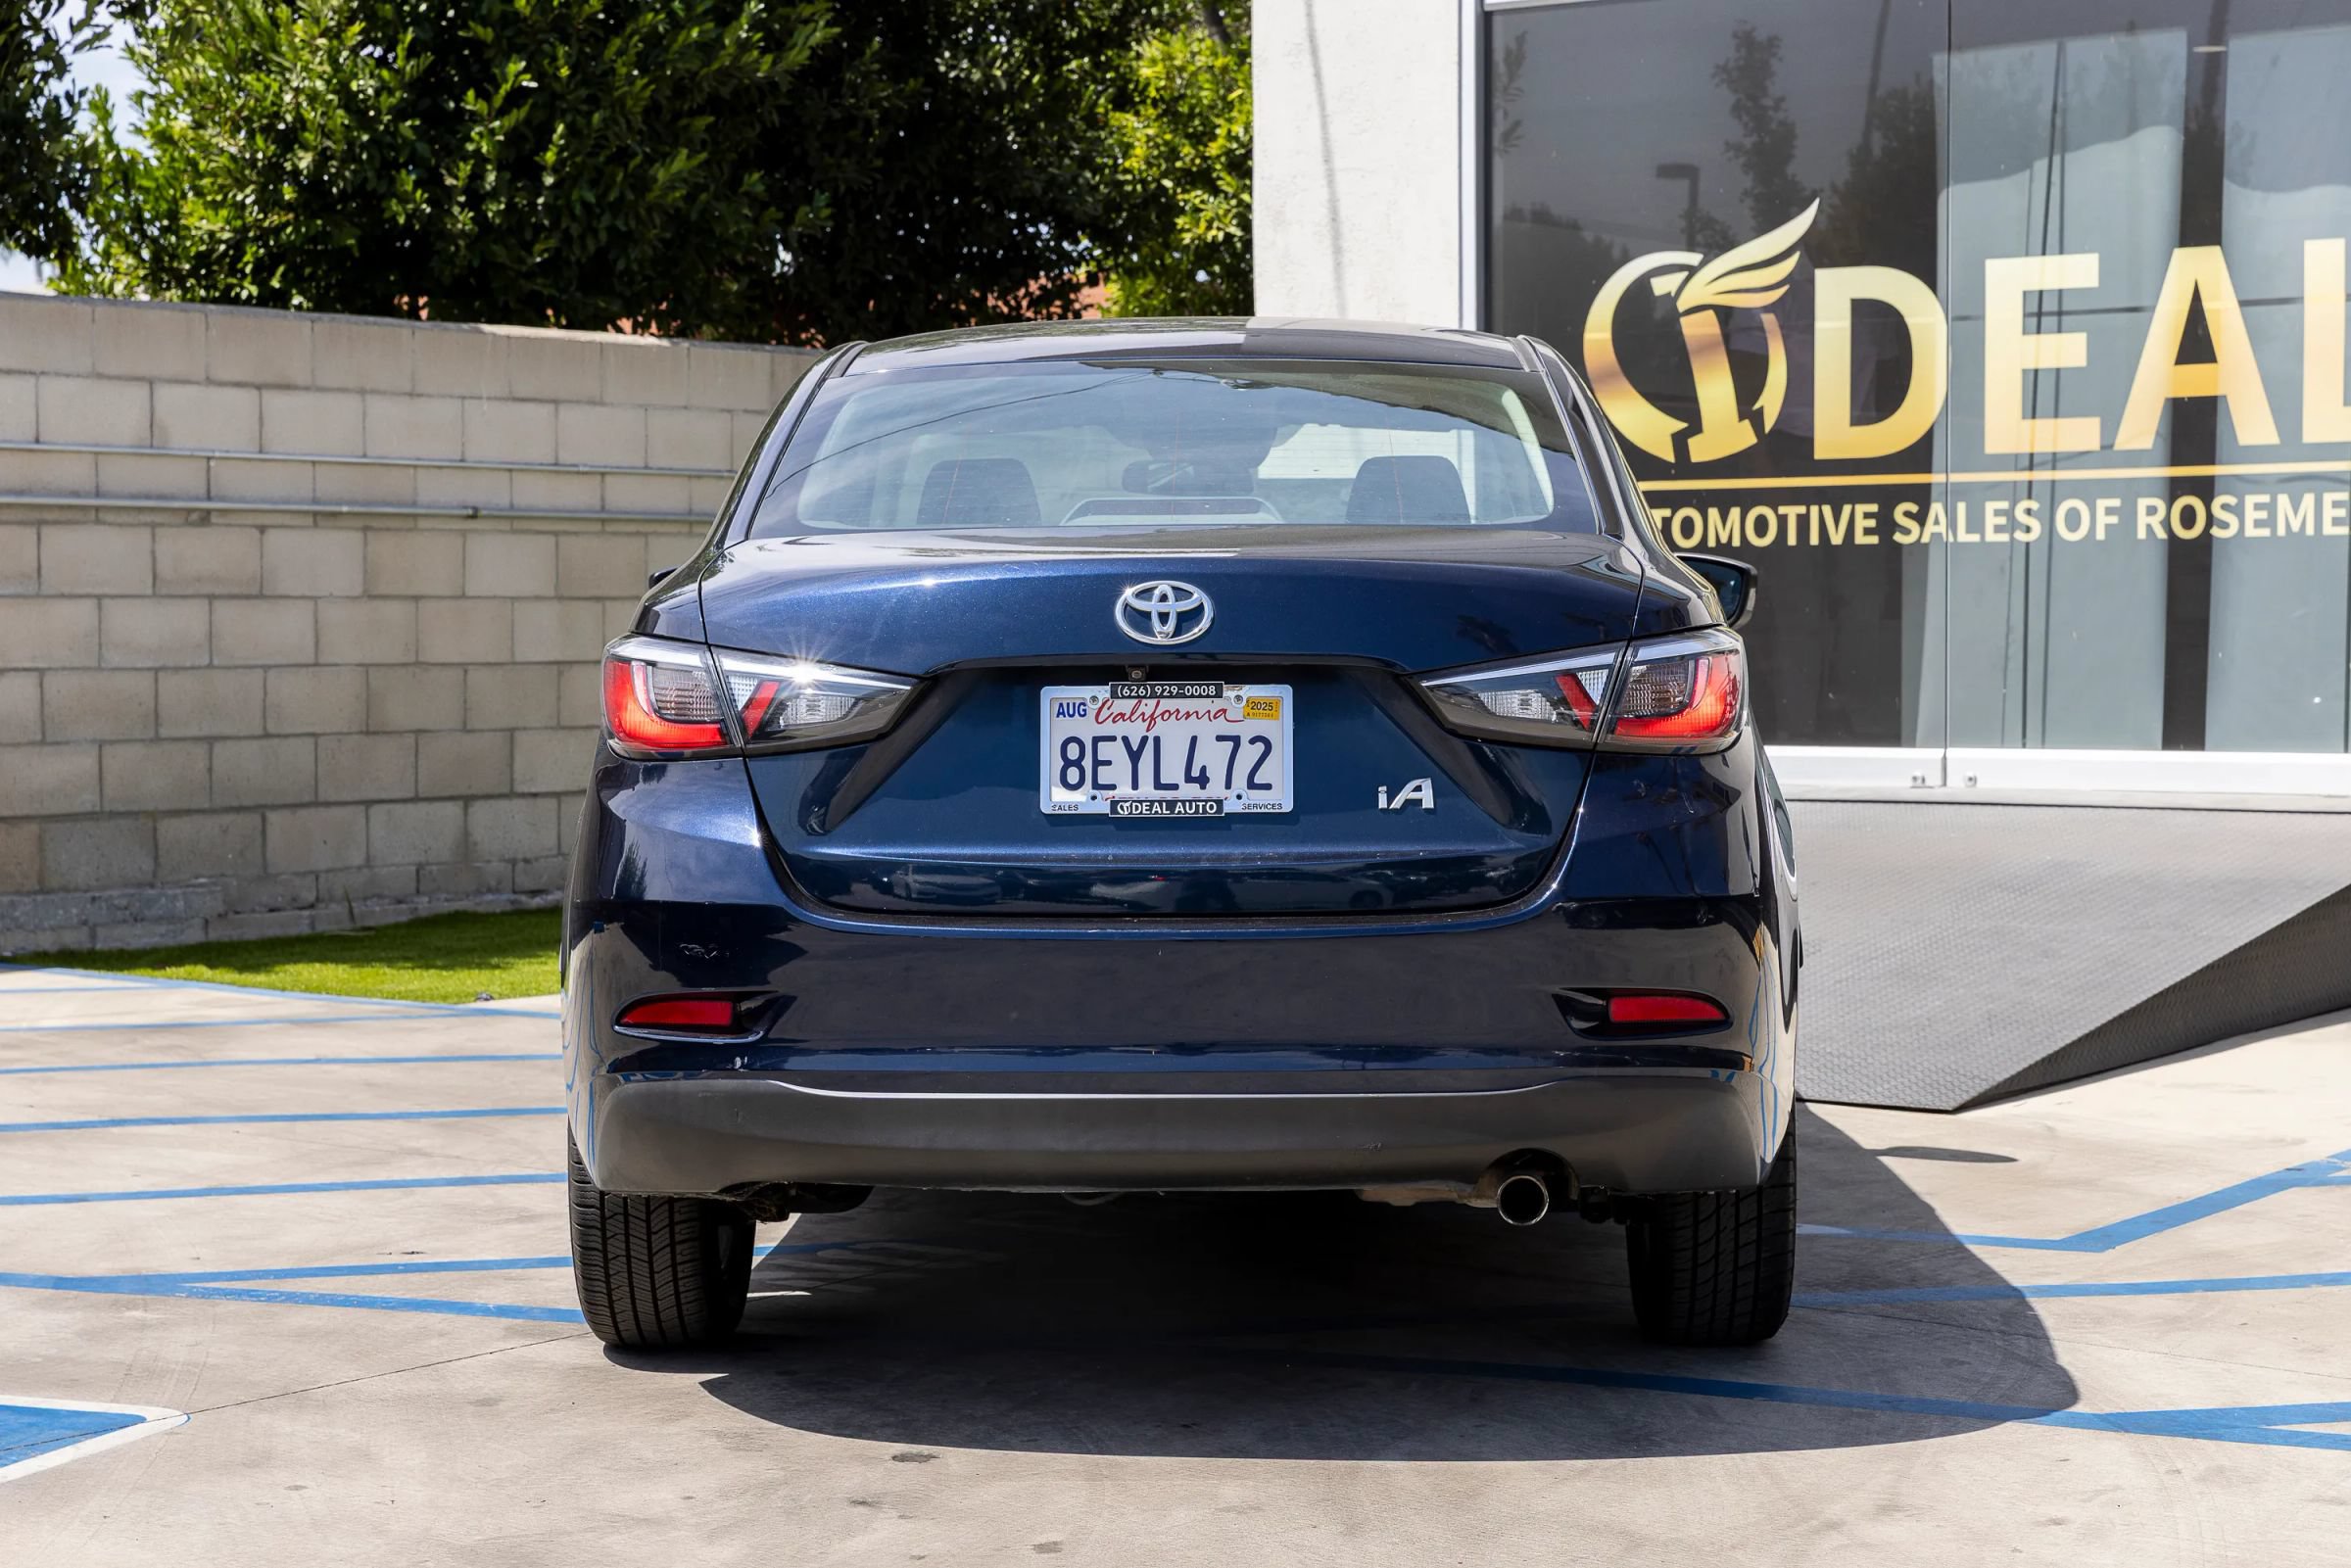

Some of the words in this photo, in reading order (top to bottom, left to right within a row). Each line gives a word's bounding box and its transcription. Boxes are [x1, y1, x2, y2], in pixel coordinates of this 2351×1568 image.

[1893, 497, 2042, 546] SALES
[2055, 498, 2122, 542] OF
[2136, 492, 2350, 540] ROSEME
[1118, 686, 1151, 697] (626)
[1154, 686, 1217, 696] 929-0008
[1055, 701, 1088, 718] AUG
[1250, 701, 1273, 711] 2025
[1093, 697, 1245, 733] California
[1059, 735, 1273, 791] 8EYL472
[1378, 778, 1435, 809] iA
[1175, 801, 1218, 814] AUTO
[1241, 802, 1283, 811] SERVICES
